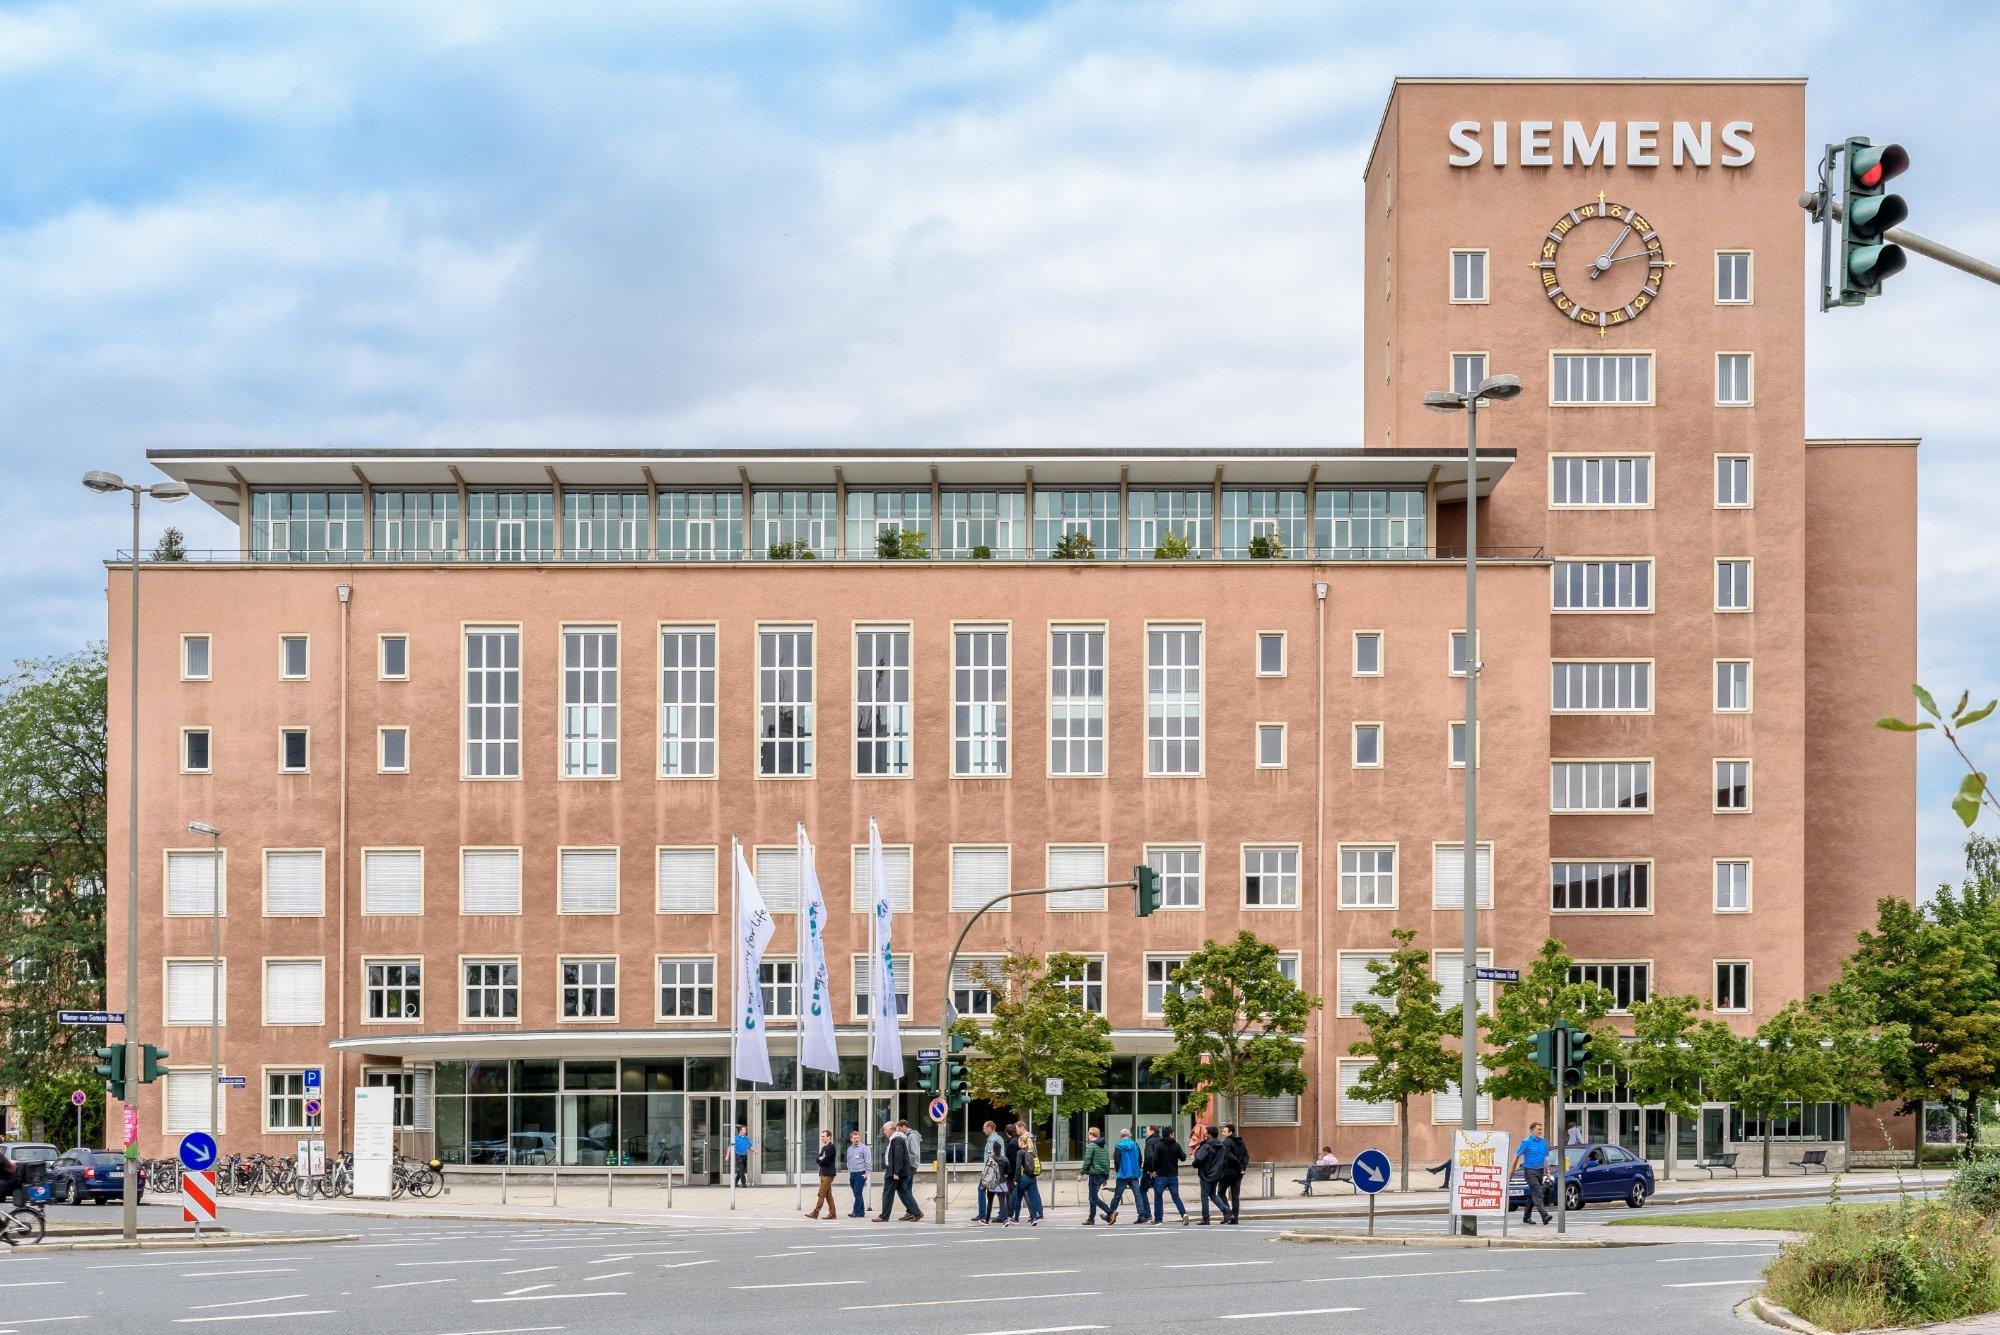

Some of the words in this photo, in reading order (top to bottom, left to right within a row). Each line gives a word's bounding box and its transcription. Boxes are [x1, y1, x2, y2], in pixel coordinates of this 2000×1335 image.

[1448, 120, 1756, 168] SIEMENS
[750, 908, 767, 927] life
[308, 1072, 316, 1085] P
[1463, 1199, 1474, 1207] DIE
